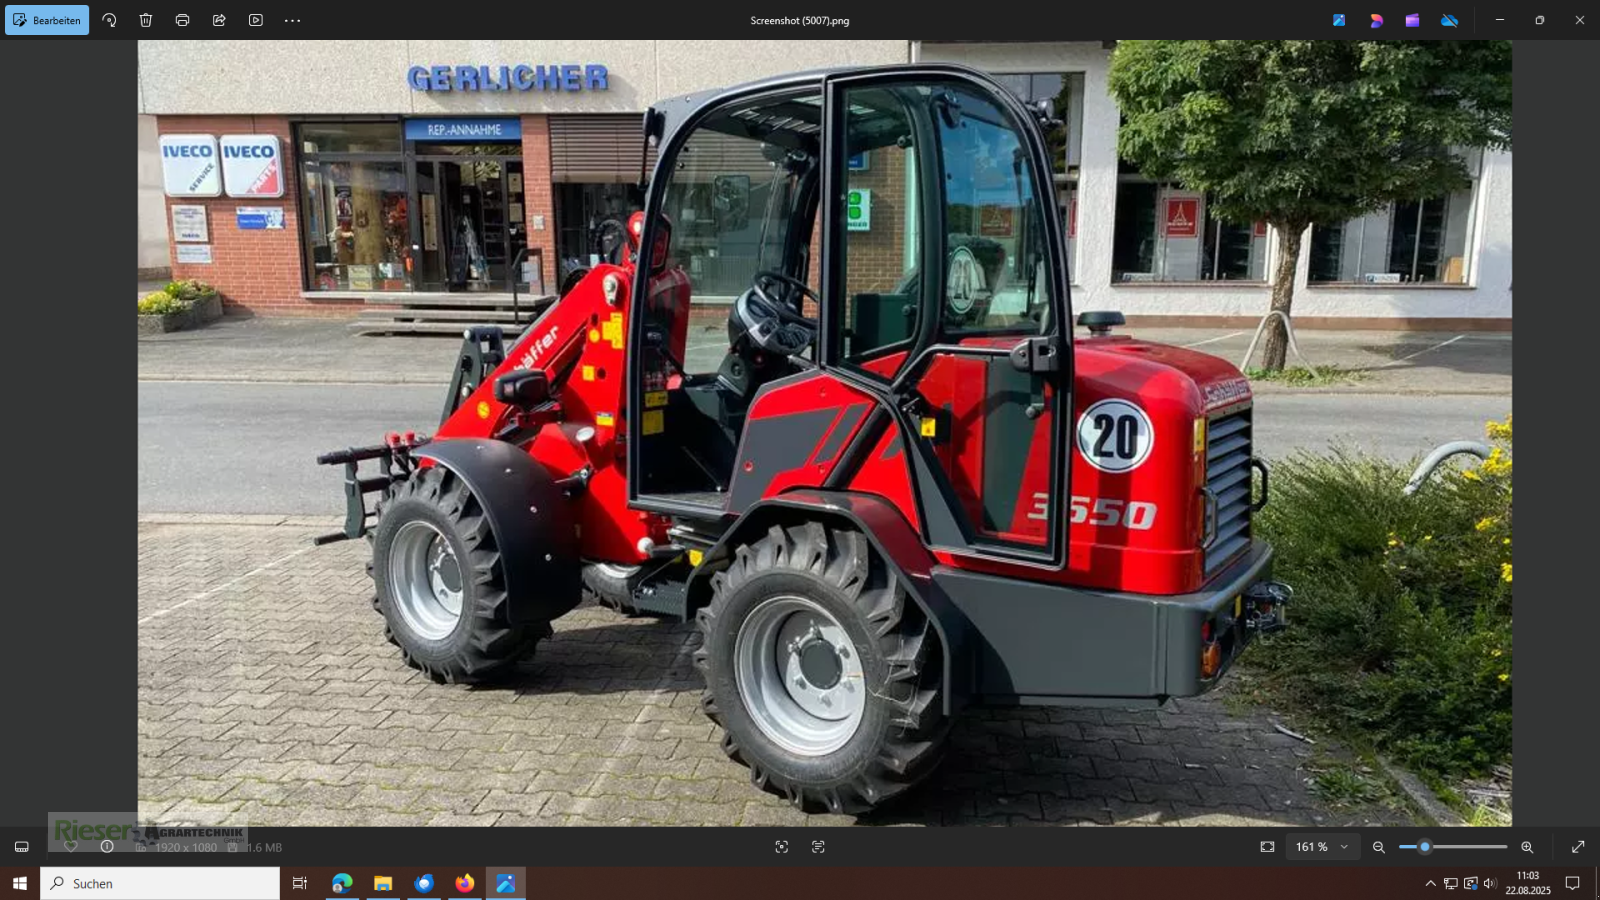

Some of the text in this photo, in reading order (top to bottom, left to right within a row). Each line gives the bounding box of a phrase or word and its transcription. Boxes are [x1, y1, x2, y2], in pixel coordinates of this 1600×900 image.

[33, 14, 81, 26] Bearbeiten
[750, 15, 850, 28] Screenshot (5007).png
[407, 64, 609, 92] GERLICHER
[427, 123, 502, 136] REP.-ANNAHME
[163, 145, 212, 158] IVECO
[224, 145, 274, 159] IVECO
[189, 163, 214, 192] SERVICE
[1093, 413, 1138, 459] 20
[156, 842, 180, 853] 1920
[192, 842, 217, 853] 1080
[265, 842, 282, 853] MB
[1296, 841, 1314, 852] 161
[1516, 871, 1540, 881] 11:03
[73, 878, 113, 890] Suchen
[1505, 886, 1551, 896] 22.08.2025
